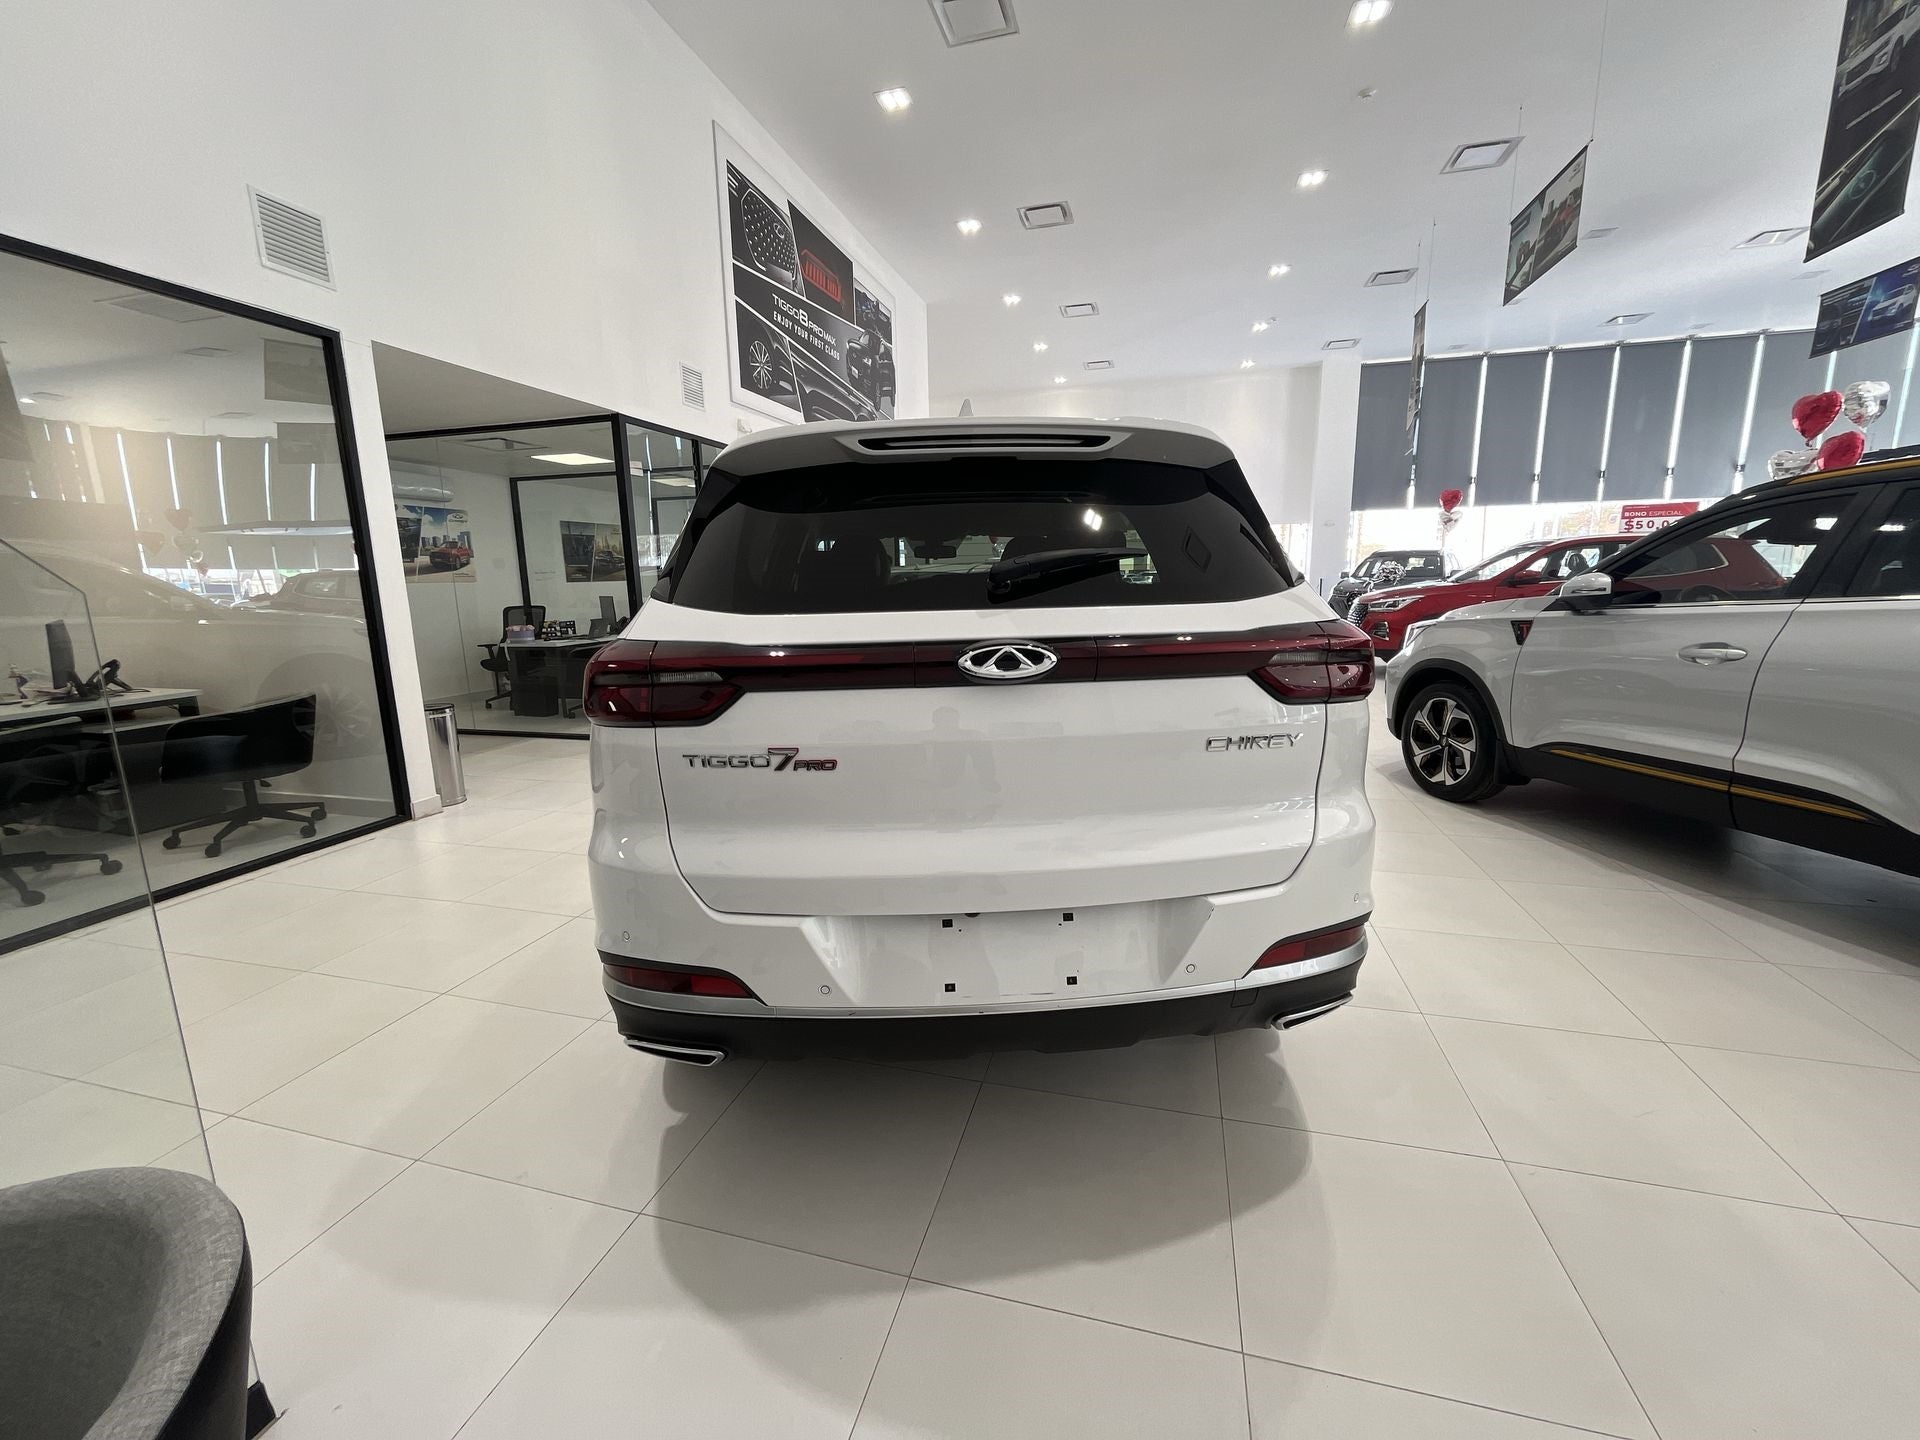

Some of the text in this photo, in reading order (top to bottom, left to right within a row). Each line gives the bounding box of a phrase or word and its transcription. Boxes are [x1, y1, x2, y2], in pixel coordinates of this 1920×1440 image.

[773, 310, 840, 360] ENJOY YOUR FIRST CLASS
[1206, 732, 1304, 752] CHIREY
